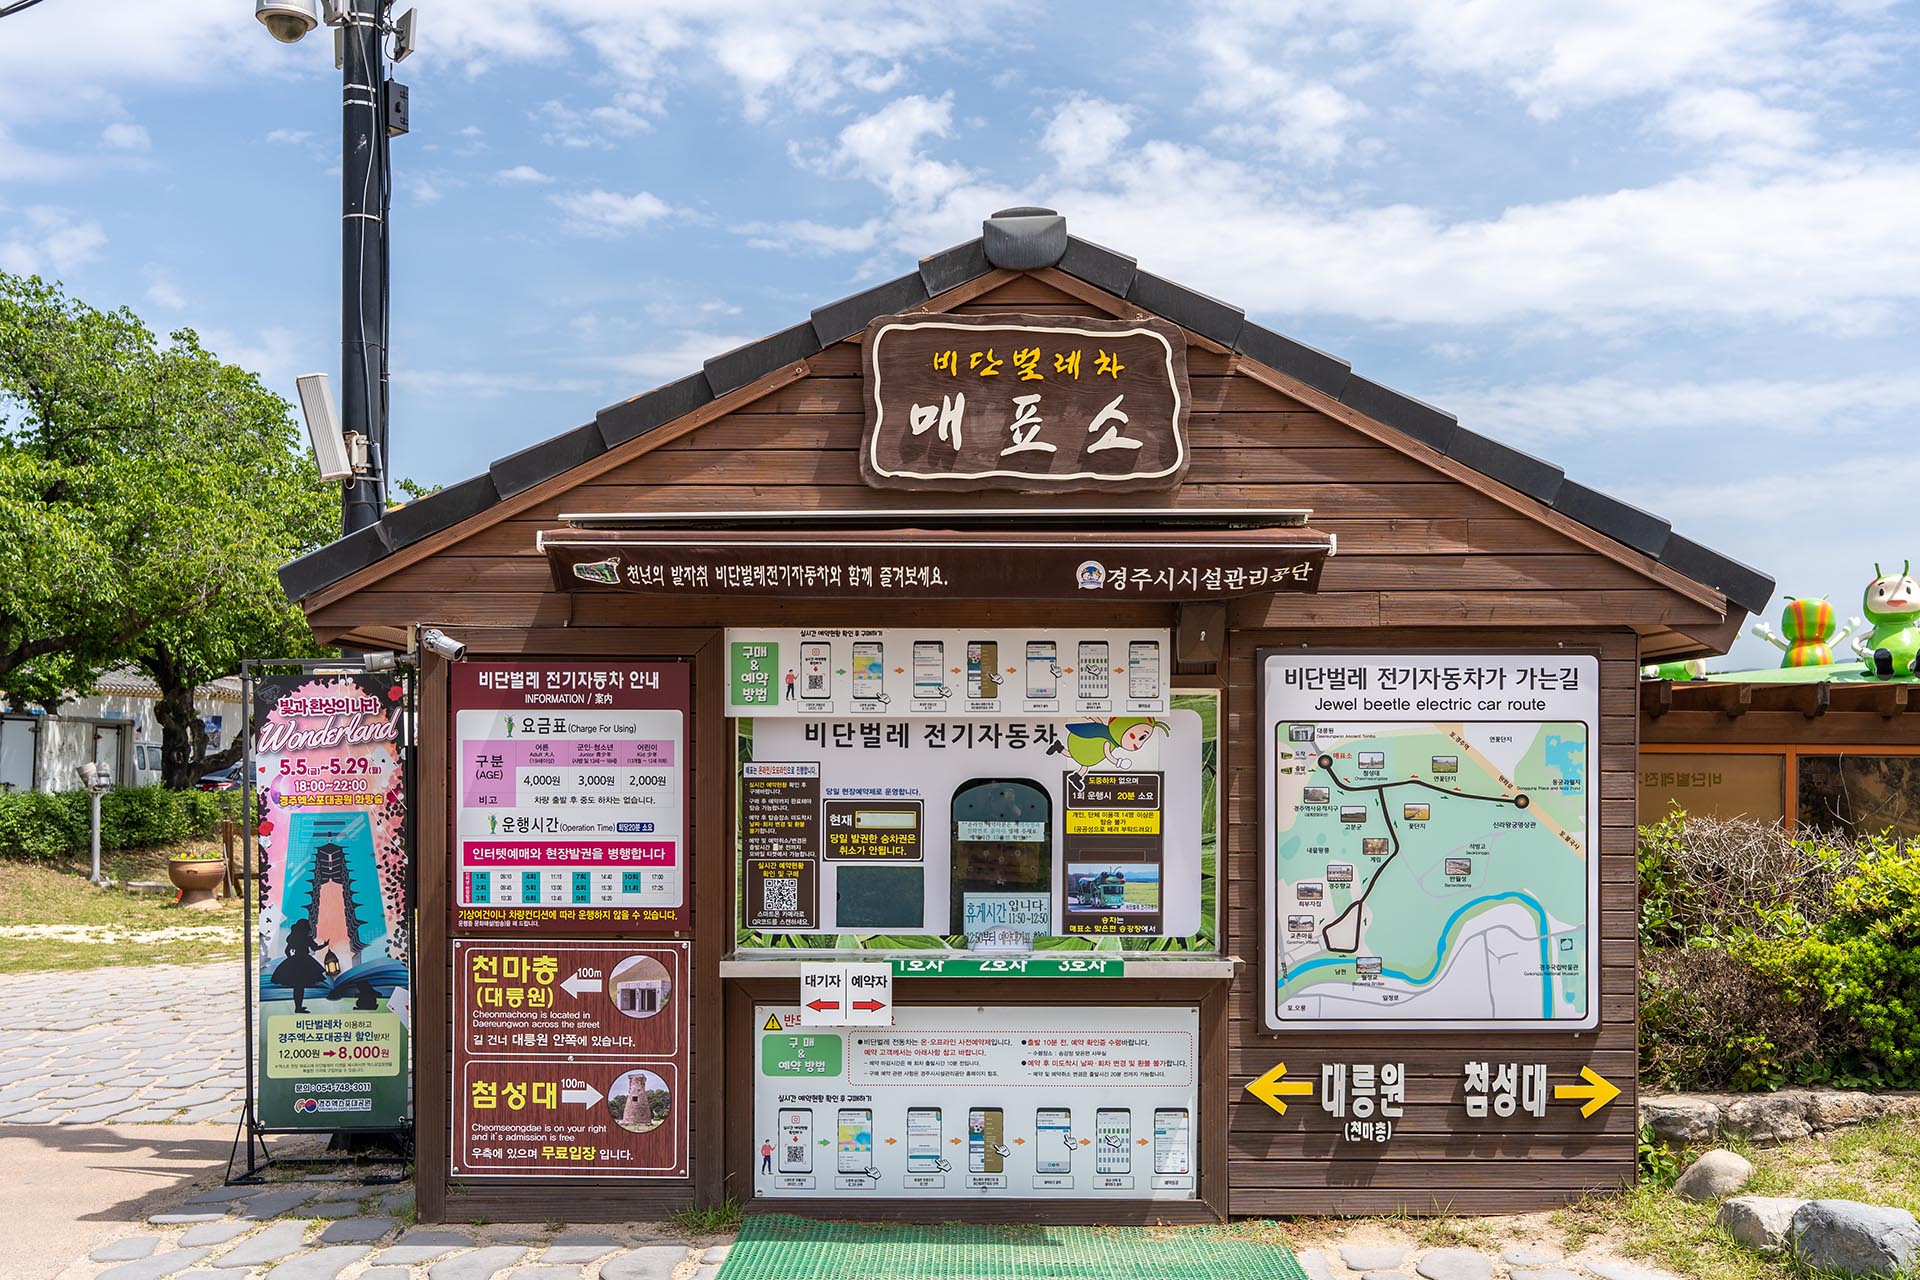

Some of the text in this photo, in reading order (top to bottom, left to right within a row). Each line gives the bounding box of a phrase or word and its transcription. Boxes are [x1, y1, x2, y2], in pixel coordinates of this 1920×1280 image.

[910, 393, 1143, 456] 매표소
[627, 565, 948, 587] 천년의 발자취 비단벌레전기자동차와 함께 즐겨보세요.
[1107, 562, 1312, 591] 경주시시설관리공단
[743, 646, 767, 659] 구매
[751, 660, 759, 671] &
[479, 671, 659, 689] 비단벌레 전기자동차 안내
[741, 673, 768, 684] 예약
[1285, 668, 1578, 690] 비단벌레 전기자동차가 가는길
[525, 694, 612, 704] INFORMATION 案内
[743, 688, 767, 702] 방법
[280, 698, 379, 714] 빛과 환상의 나라
[1315, 698, 1546, 711] Jewel beetle electric car route
[260, 707, 402, 754] Wonderland
[521, 718, 636, 734] 요금표 (Charge For Using)
[805, 722, 1058, 750] 비단벌레 전기자동차
[476, 755, 504, 768] 구분
[476, 770, 503, 780] (AGE)
[295, 780, 367, 792] 18:00~22:00
[524, 776, 666, 787] 4,000원 3,000원 2,000원
[279, 795, 352, 806] 경주엑스포대공원
[479, 796, 498, 804] 비고
[598, 796, 620, 804] 하차는
[623, 796, 655, 804] 없습니다.
[1073, 792, 1084, 800] 1회
[502, 817, 558, 833] 운행시간
[560, 824, 596, 832] (Operation
[598, 824, 615, 832] Time)
[830, 814, 852, 826] 현재
[830, 834, 916, 844] 당일 발권한 승차권은
[546, 849, 603, 860] 현장발권을
[608, 849, 665, 860] 병행합니다
[839, 846, 906, 856] 취소가 안됩니다.
[458, 910, 677, 920] 기상여건이나 차량컨디션에 따라 운행하지 않을 수 있습니다.
[966, 900, 1047, 924] 휴게시간 입니다.
[1009, 913, 1047, 924] 11:50~12:50
[472, 955, 558, 985] 천마총
[578, 968, 601, 978] 100m
[805, 974, 888, 988] 대기자 예약자
[476, 987, 554, 1009] (대릉원)
[473, 1010, 590, 1020] Cheonmachong is located in
[296, 1020, 342, 1030] 비단벌레차
[473, 1020, 529, 1029] Daereungwon
[561, 1020, 574, 1028] the
[279, 1032, 352, 1042] 경주엑스포대공원
[473, 1034, 636, 1047] 길 건너 대릉원 안쪽에 있습니다.
[789, 1038, 815, 1048] 구매
[279, 1046, 389, 1060] 12,000원 8,000원
[798, 1050, 806, 1058] &
[778, 1061, 825, 1072] 예약 방법
[561, 1079, 585, 1088] 100m
[1322, 1061, 1547, 1118] 대릉원 첨성대
[472, 1081, 557, 1110] 첨성대
[472, 1124, 542, 1133] Cheomseongdae
[545, 1124, 551, 1132] is
[567, 1125, 585, 1133] your
[589, 1124, 606, 1133] right
[1344, 1122, 1392, 1143] (천마총)
[472, 1133, 487, 1141] and
[506, 1133, 547, 1141] admission
[550, 1133, 556, 1141] is
[559, 1133, 575, 1141] free
[472, 1146, 633, 1161] 우측에 있으며 무료입장 입니다.
